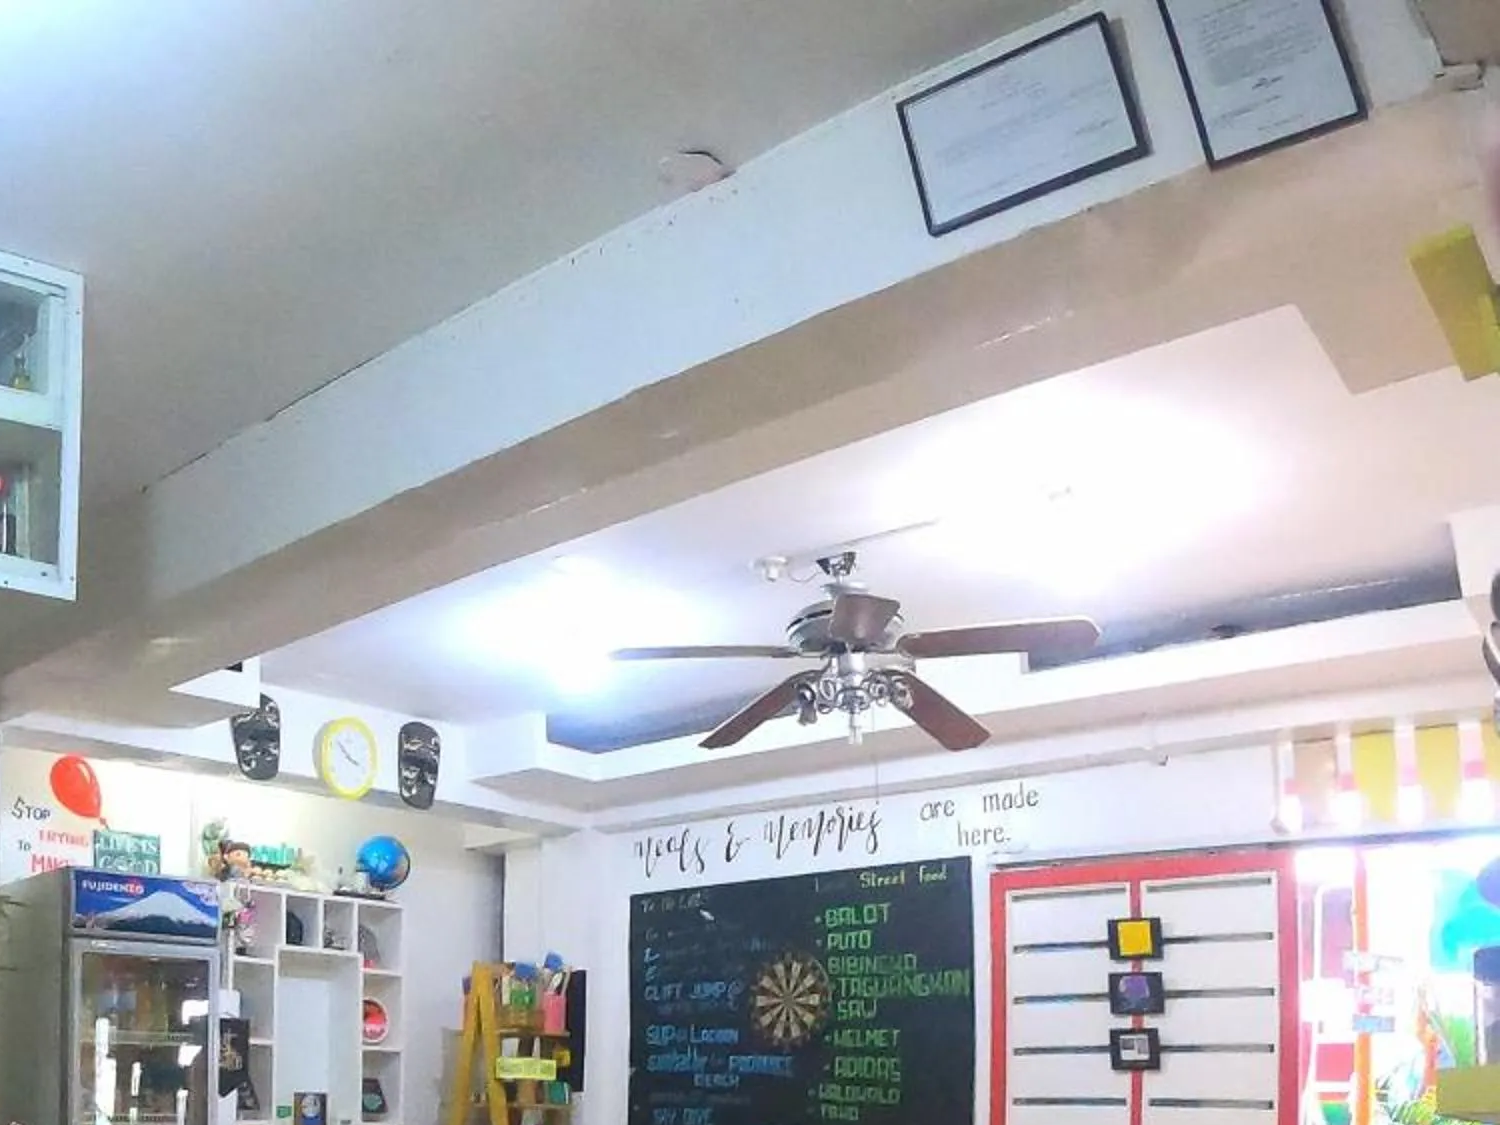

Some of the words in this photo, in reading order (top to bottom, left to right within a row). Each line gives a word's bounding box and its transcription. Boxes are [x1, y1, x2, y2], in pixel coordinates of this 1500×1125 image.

[919, 799, 956, 822] are
[982, 781, 1040, 813] made
[956, 821, 1011, 848] here.
[81, 878, 145, 896] FUJIDENZO
[859, 869, 905, 889] Street
[825, 903, 891, 929] BALOT
[827, 930, 873, 950] PUTO
[833, 1029, 900, 1048] HELMET
